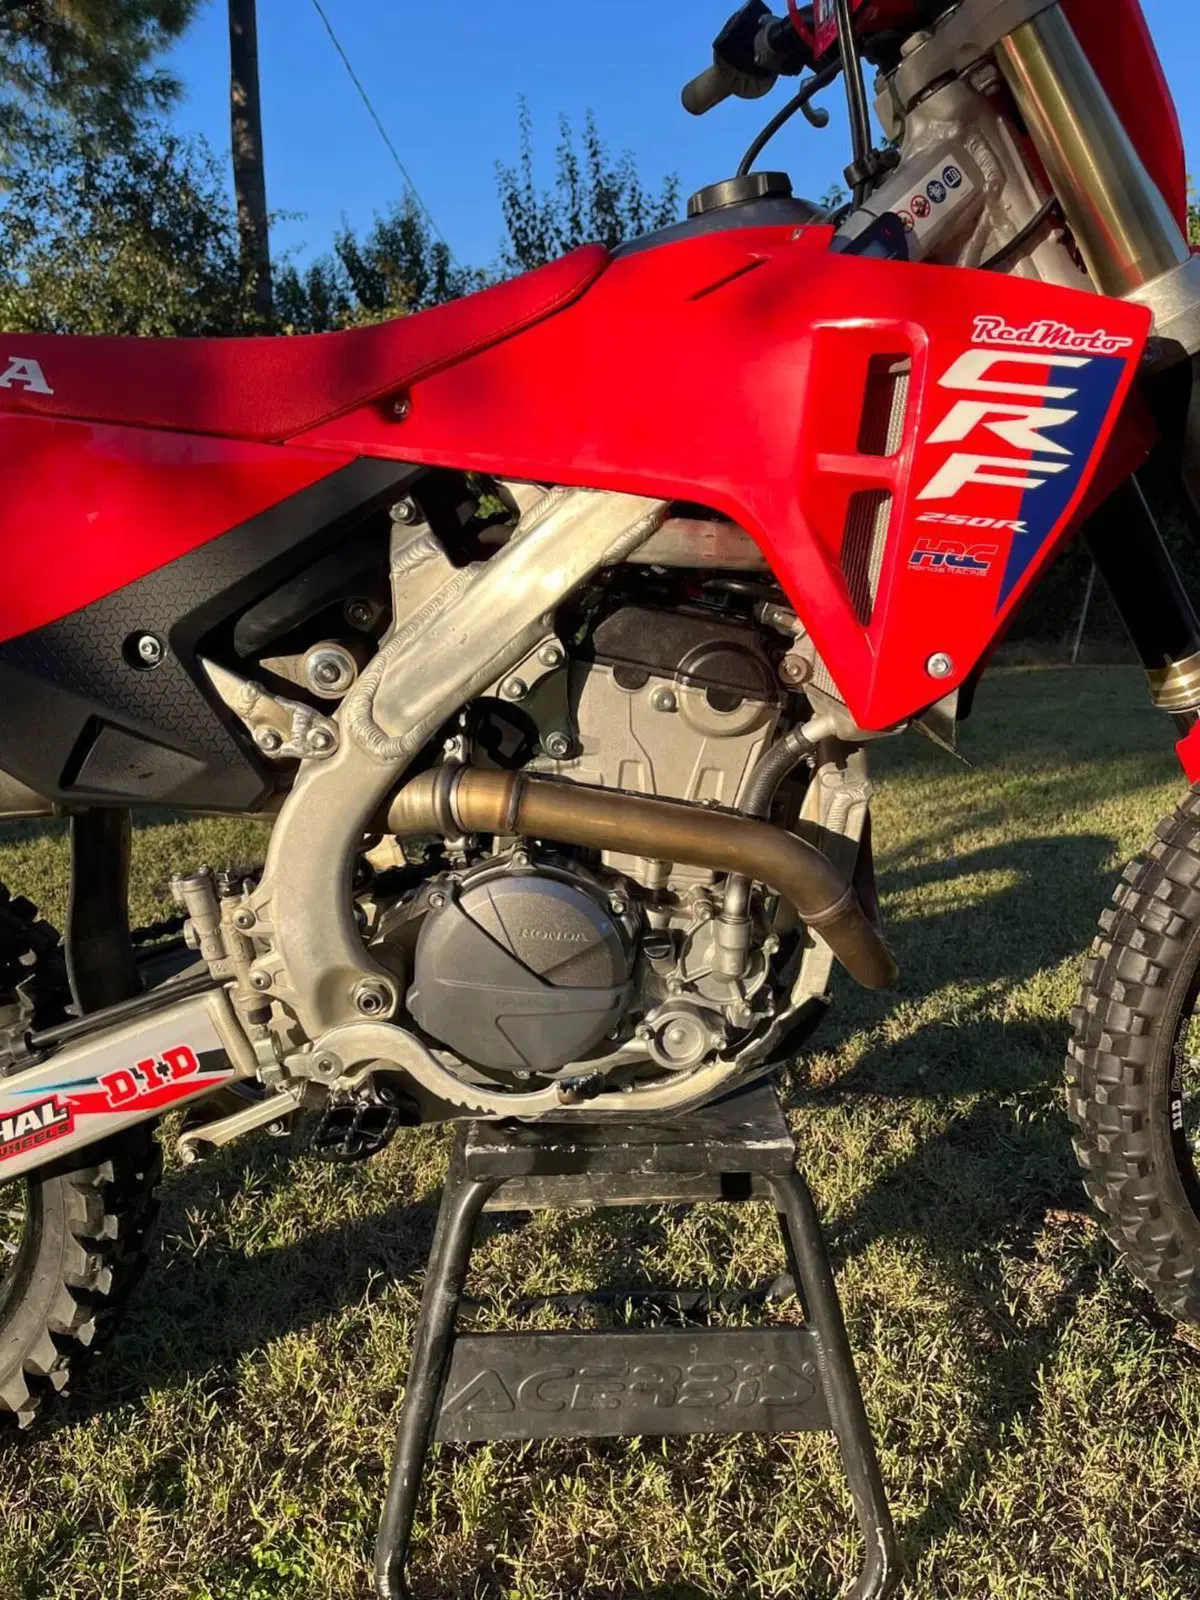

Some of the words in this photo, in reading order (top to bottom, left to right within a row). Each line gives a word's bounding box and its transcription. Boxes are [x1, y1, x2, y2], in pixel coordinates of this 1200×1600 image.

[971, 315, 1133, 354] RedMoto
[0, 356, 54, 395] A
[915, 512, 1029, 533] 250R
[908, 537, 999, 571] HRC
[519, 928, 588, 942] HONDA
